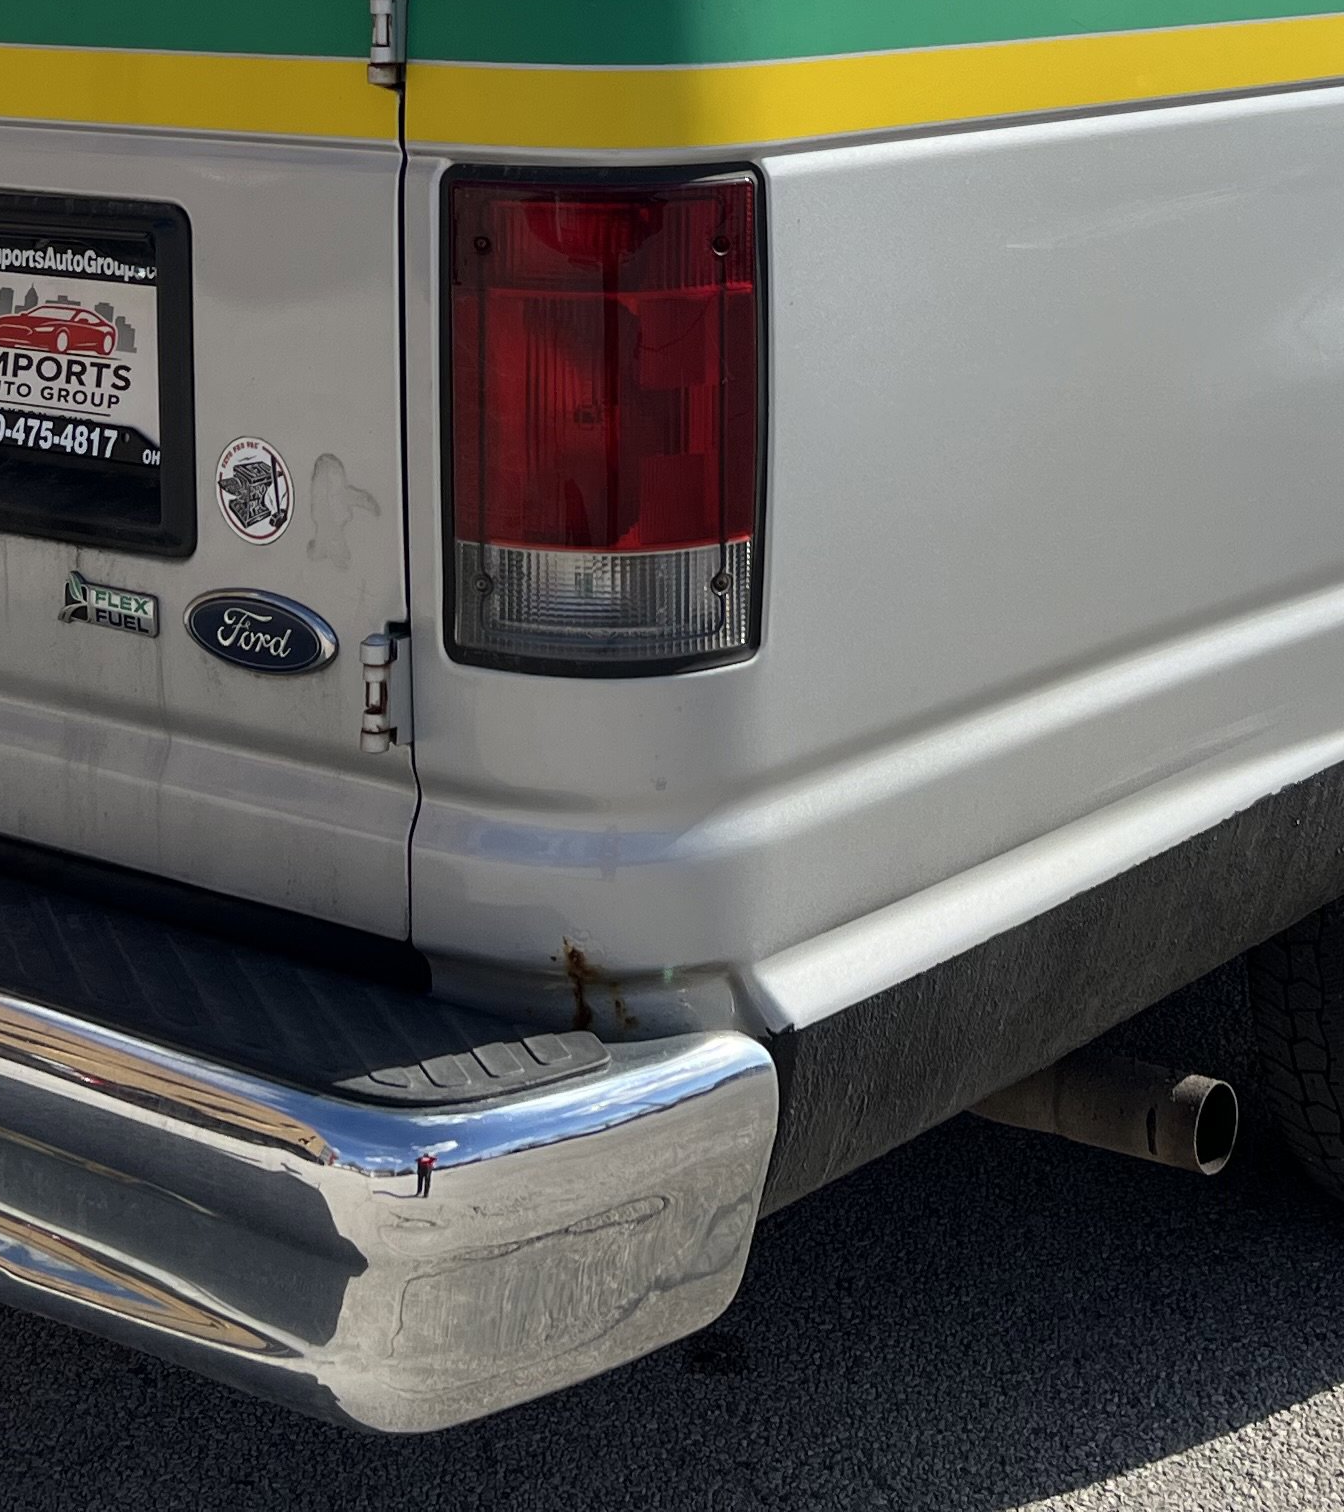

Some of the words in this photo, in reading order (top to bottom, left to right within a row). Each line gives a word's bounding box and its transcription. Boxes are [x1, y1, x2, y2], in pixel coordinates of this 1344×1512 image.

[40, 386, 120, 409] GROUP
[142, 449, 161, 466] OH
[94, 590, 149, 615] FLEX
[96, 610, 150, 634] FUEL
[217, 607, 292, 659] Ford
